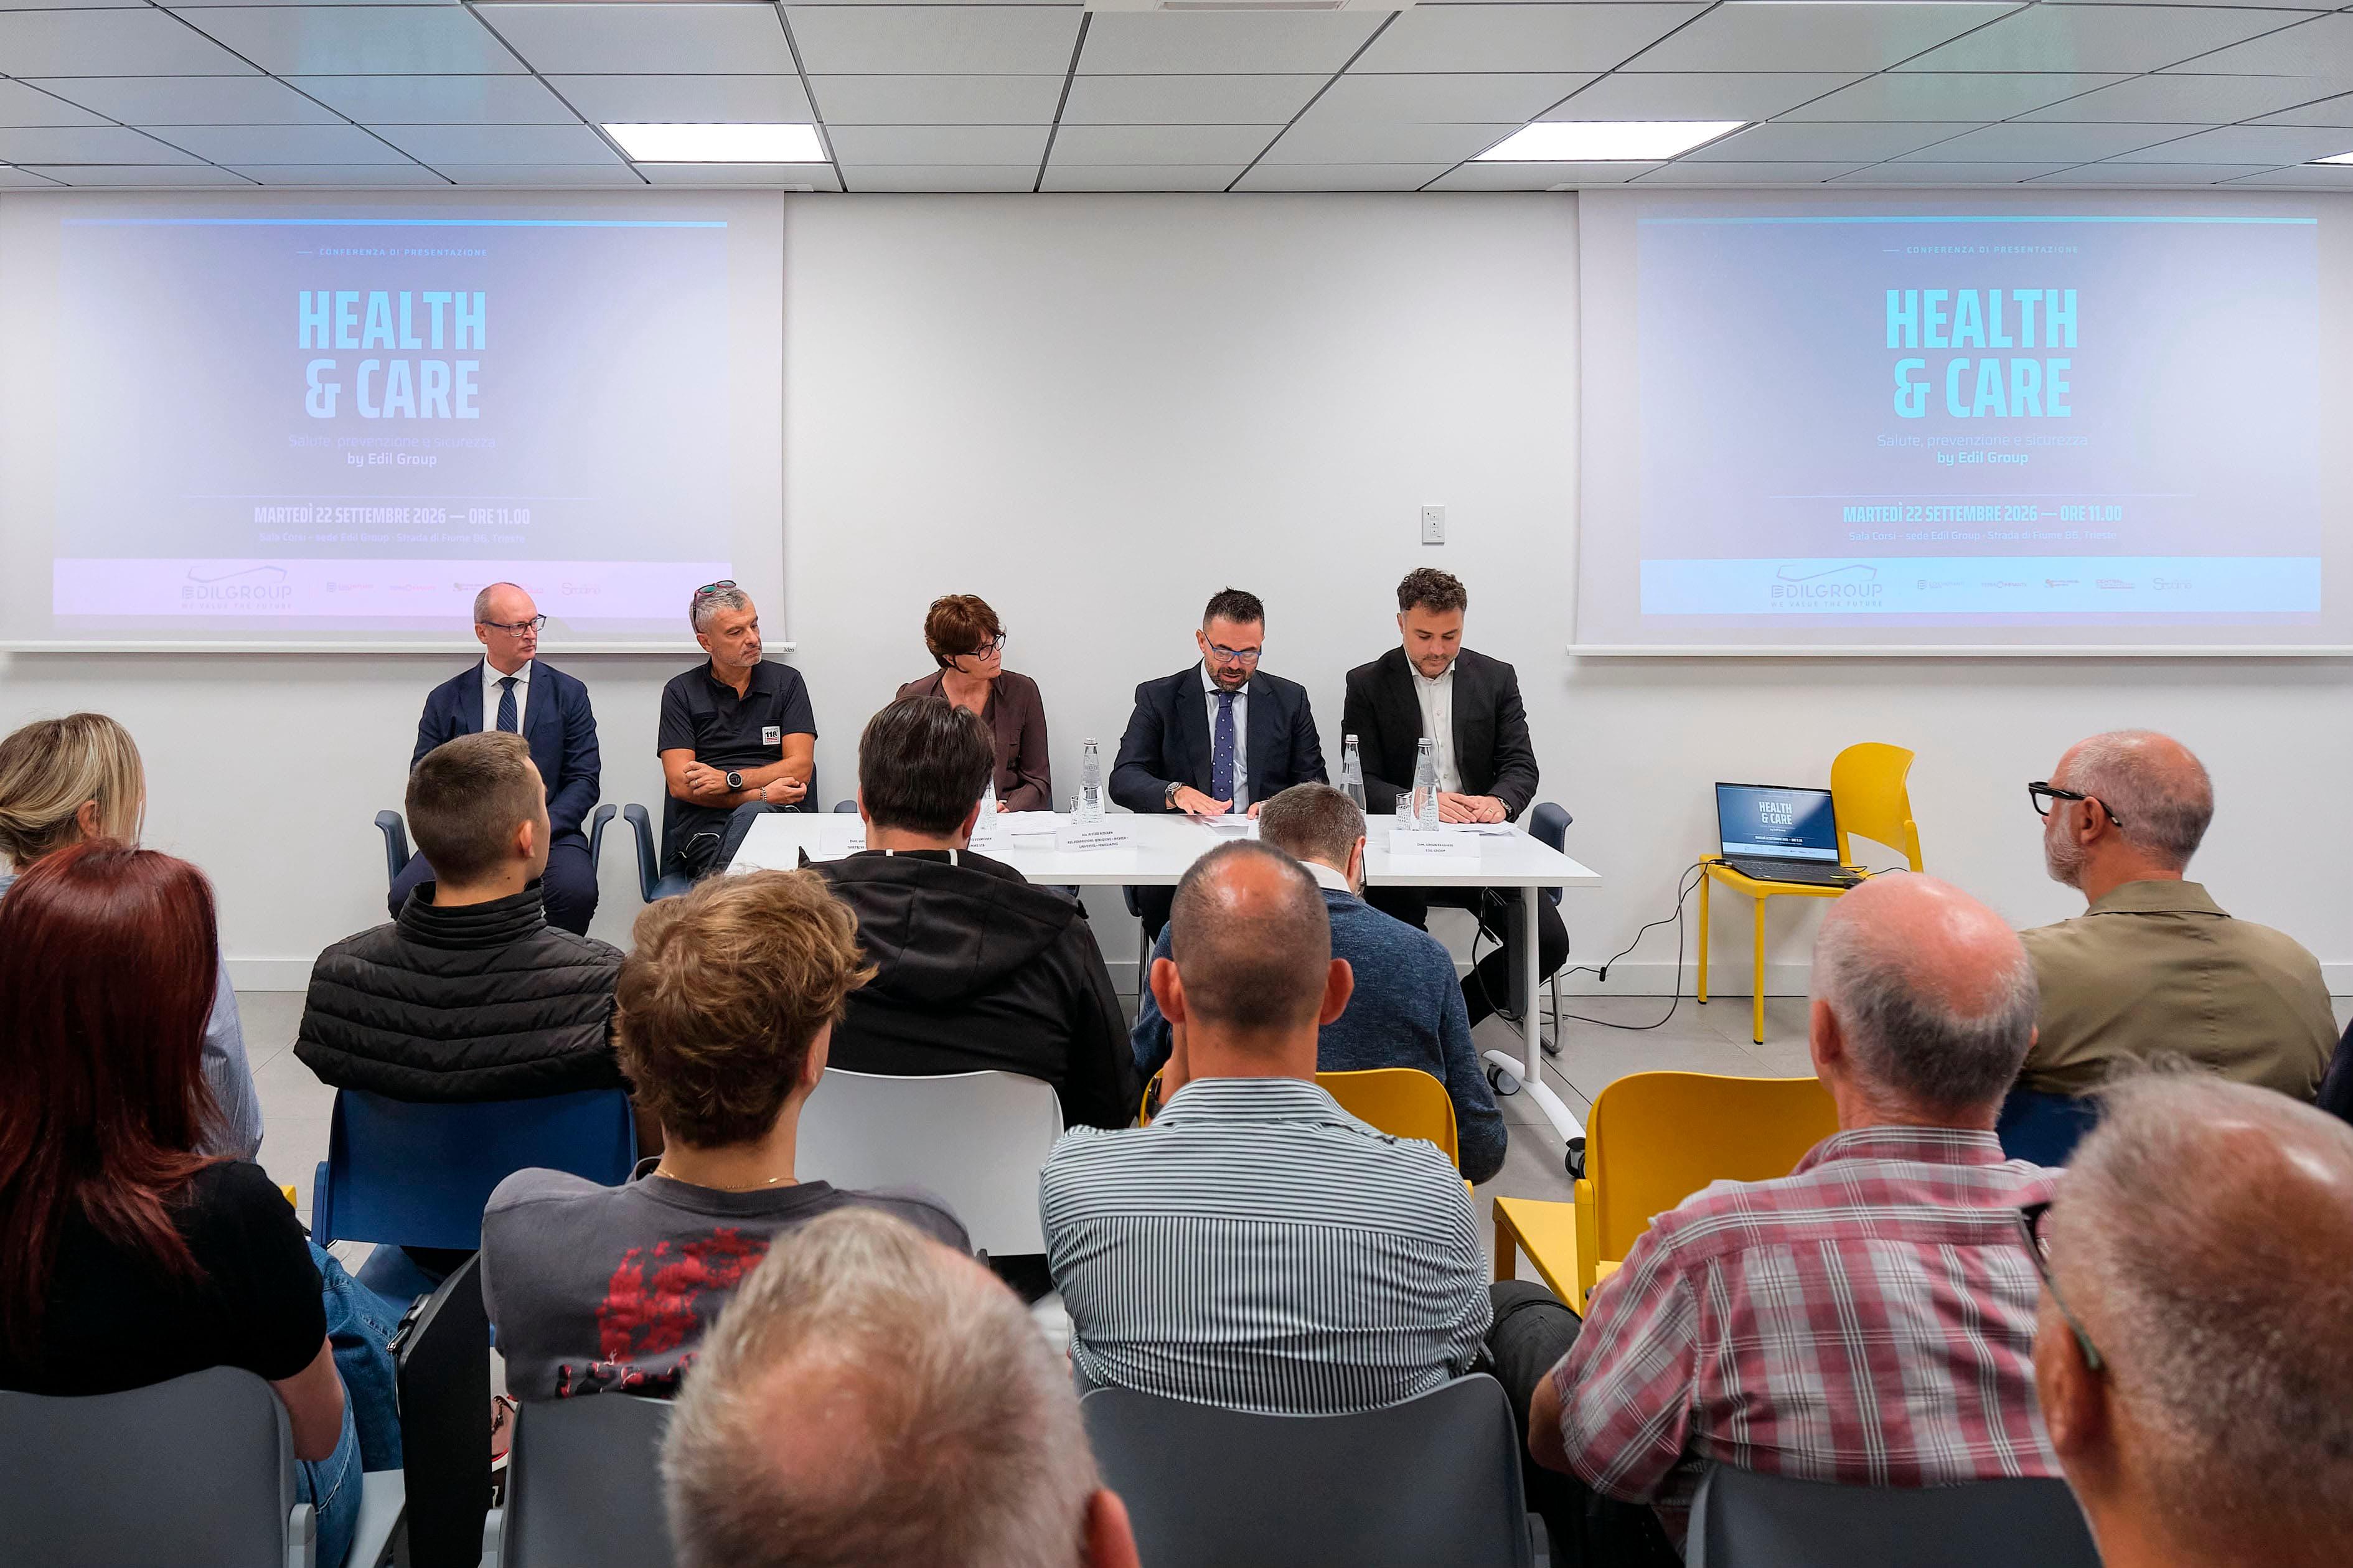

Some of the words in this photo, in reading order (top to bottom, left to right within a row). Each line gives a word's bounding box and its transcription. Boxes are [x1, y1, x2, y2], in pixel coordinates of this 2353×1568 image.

[319, 248, 385, 256] CONFERENZA
[390, 248, 400, 256] DI
[404, 248, 488, 257] PRESENTAZIONE
[1907, 246, 1975, 254] CONFERENZA
[1979, 246, 1990, 254] DI
[1993, 246, 2079, 254] PRESENTAZIONE
[299, 290, 486, 350] HEALTH
[1886, 288, 2077, 349] HEALTH
[304, 359, 342, 419] &
[356, 359, 480, 419] CARE
[1893, 357, 1931, 418] &
[1945, 357, 2072, 418] CARE
[1877, 434, 1924, 448] Salute,
[1927, 435, 2011, 449] prevenzione
[2013, 437, 2022, 446] e
[2026, 434, 2088, 446] sicurezza
[347, 453, 364, 467] by
[368, 453, 393, 465] Edil
[397, 454, 438, 467] Group
[1937, 451, 1955, 466] by
[1958, 451, 1984, 464] Edil
[1987, 452, 2029, 466] Group
[254, 502, 313, 524] MARTEDÌ
[316, 507, 332, 524] 22
[335, 507, 410, 524] SETTEMBRE
[413, 507, 446, 524] 2026
[469, 508, 494, 525] ORE
[497, 508, 530, 525] 11.00
[1843, 501, 1903, 523] MARTEDÌ
[1905, 505, 1922, 523] 22
[1925, 505, 2001, 523] SETTEMBRE
[2004, 505, 2038, 522] 2026
[2060, 505, 2086, 522] ORE
[2088, 505, 2122, 522] 11.00
[1905, 531, 1929, 540] sede
[1931, 531, 1949, 540] Edil
[1951, 531, 1980, 543] Group
[1988, 530, 2020, 540] Strada
[2022, 530, 2031, 540] di
[1771, 583, 1882, 598] EDILGROUP
[1759, 802, 1792, 814] HEALTH
[1761, 812, 1769, 824] &
[1770, 813, 1793, 825] CARE
